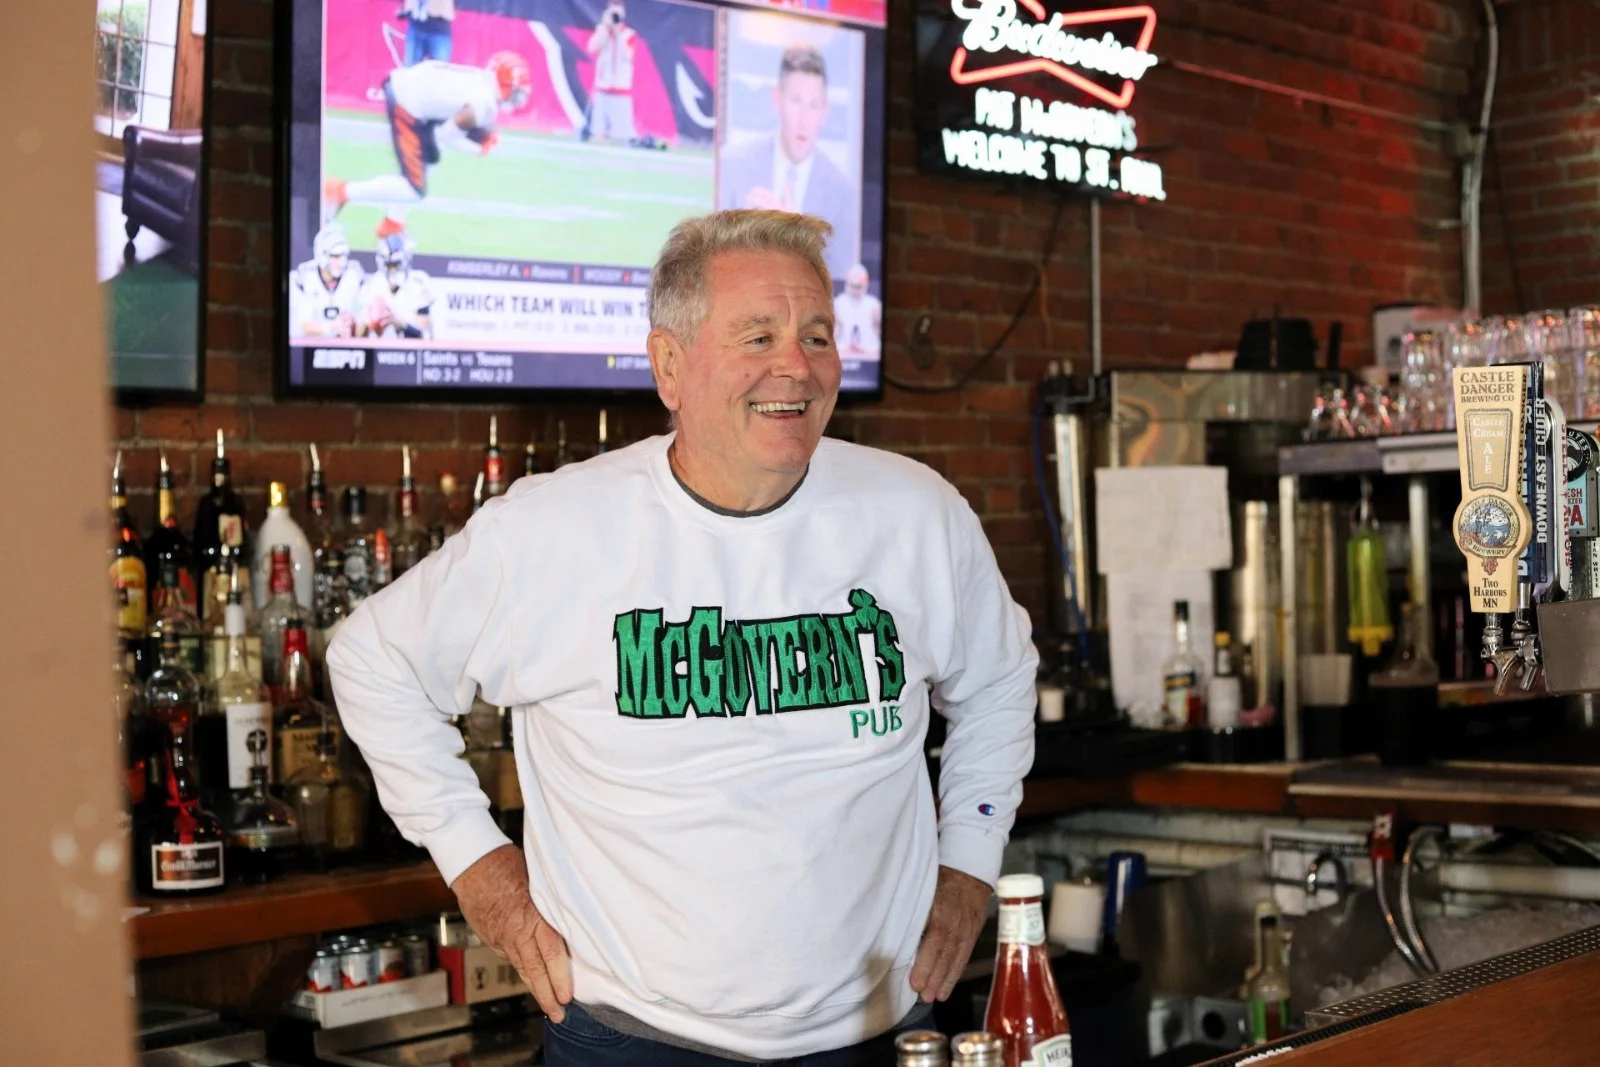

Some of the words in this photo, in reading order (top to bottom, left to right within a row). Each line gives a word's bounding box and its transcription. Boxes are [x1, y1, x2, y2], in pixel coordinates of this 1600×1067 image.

[446, 294, 505, 313] WHICH
[511, 295, 554, 315] TEAM
[559, 297, 597, 316] WILL
[602, 299, 634, 317] WIN
[313, 350, 366, 369] ESPN
[1460, 371, 1515, 383] CASTLE
[1461, 383, 1515, 395] DANGER
[1461, 394, 1500, 403] BREWING
[1502, 394, 1515, 402] CO
[1535, 398, 1547, 446] CIDER
[1568, 431, 1589, 451] UTES
[1536, 450, 1548, 544] DOWNEAST
[1472, 544, 1507, 556] BREWERY
[1482, 598, 1498, 608] MN
[851, 704, 903, 739] PUB
